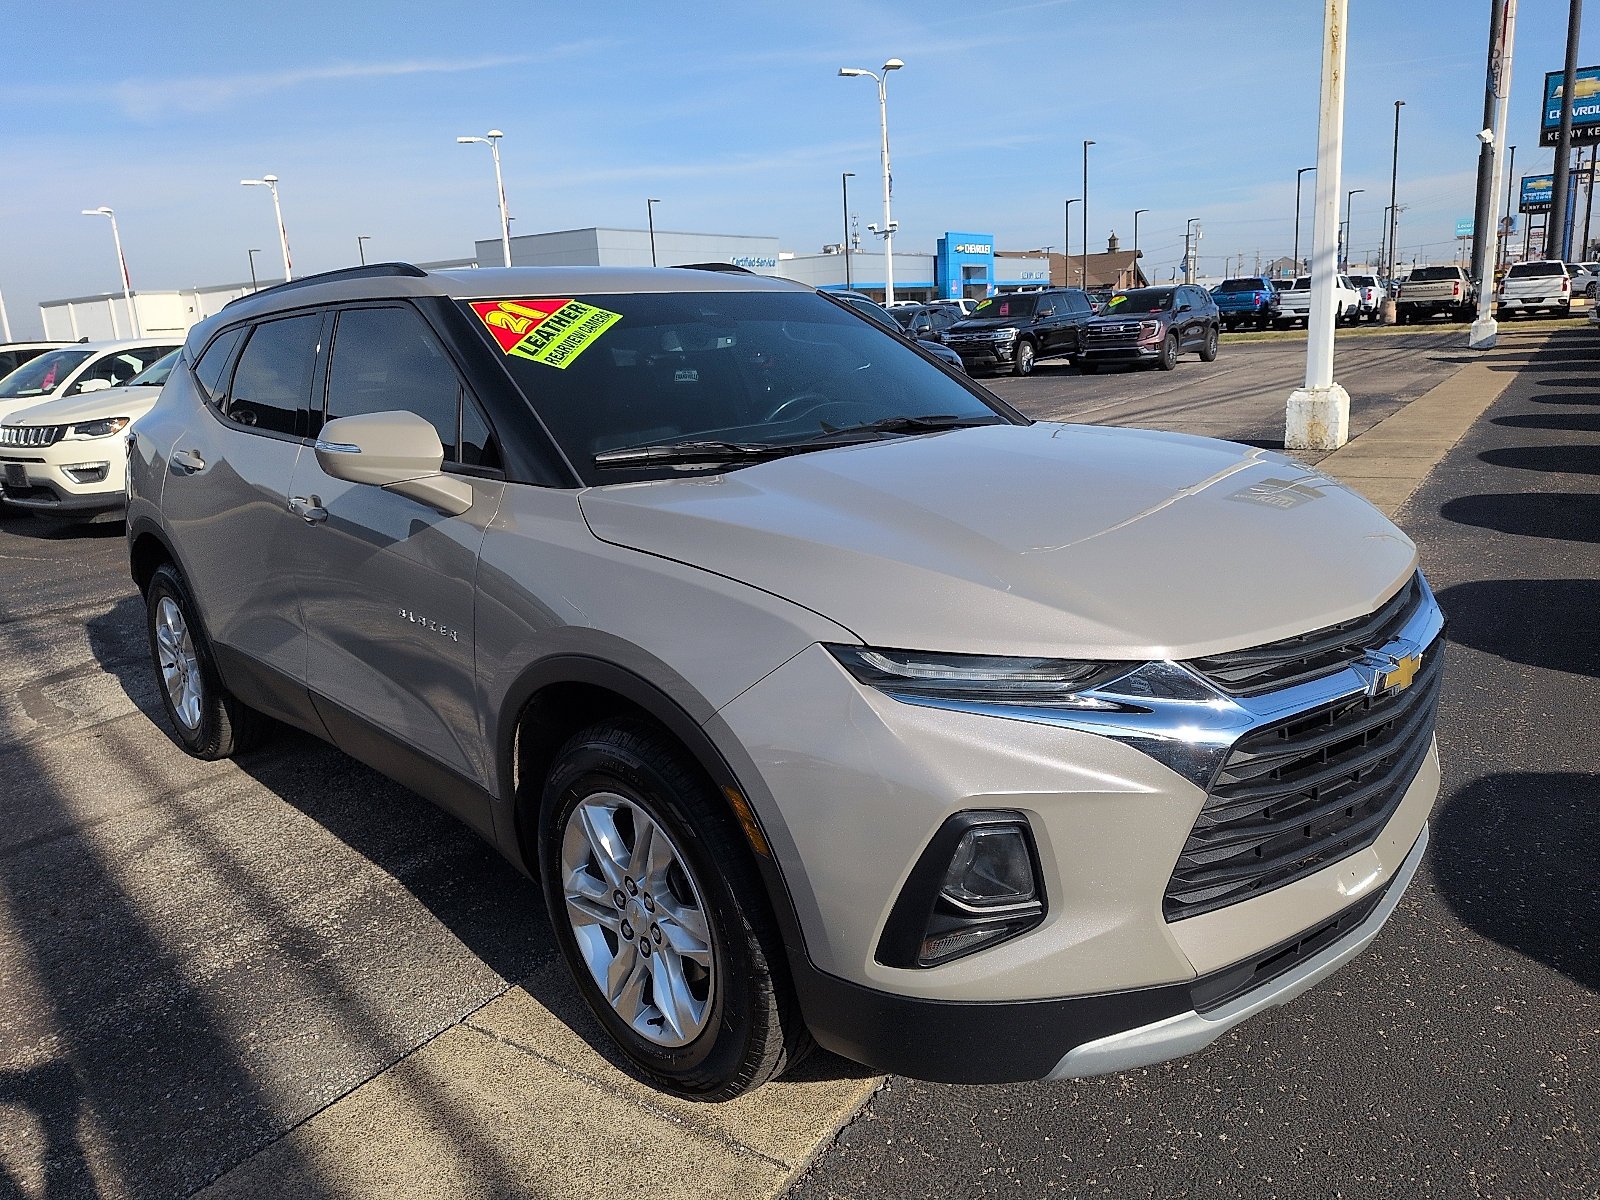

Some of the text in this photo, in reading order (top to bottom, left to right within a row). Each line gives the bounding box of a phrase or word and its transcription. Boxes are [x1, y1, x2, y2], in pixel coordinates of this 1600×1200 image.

[1547, 129, 1582, 140] KENY
[964, 244, 991, 254] CHEVROLET
[485, 302, 549, 334] 21
[516, 303, 589, 356] LEATHER
[544, 310, 614, 365] REARVIEW CAMERA
[398, 608, 459, 642] BLAZER
